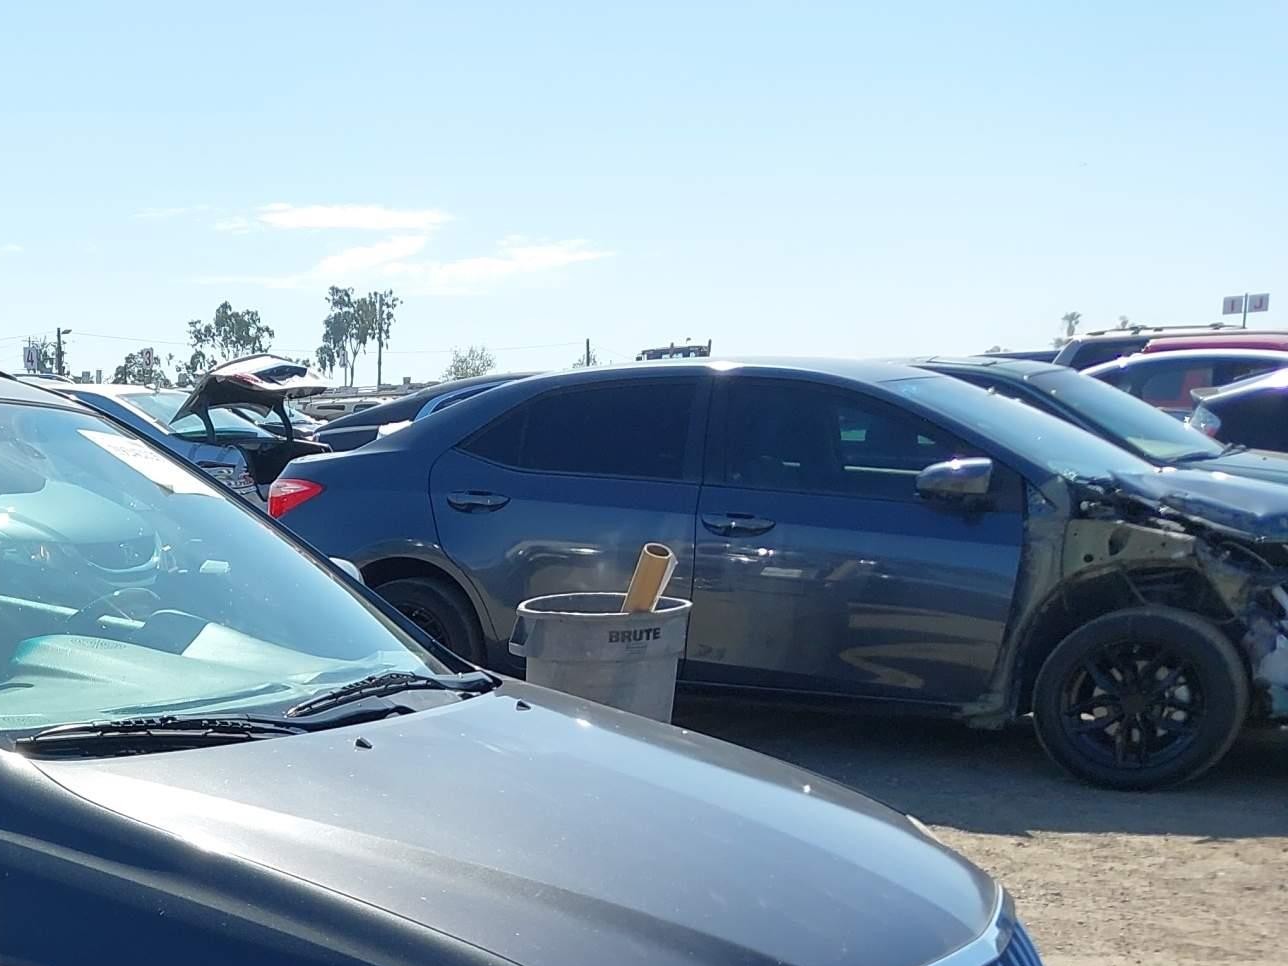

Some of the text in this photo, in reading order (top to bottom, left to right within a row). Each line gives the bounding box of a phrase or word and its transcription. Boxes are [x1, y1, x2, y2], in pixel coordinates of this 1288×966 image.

[1254, 297, 1263, 310] J
[27, 350, 34, 366] 4
[145, 350, 151, 366] 3
[608, 627, 661, 643] BRUTE
